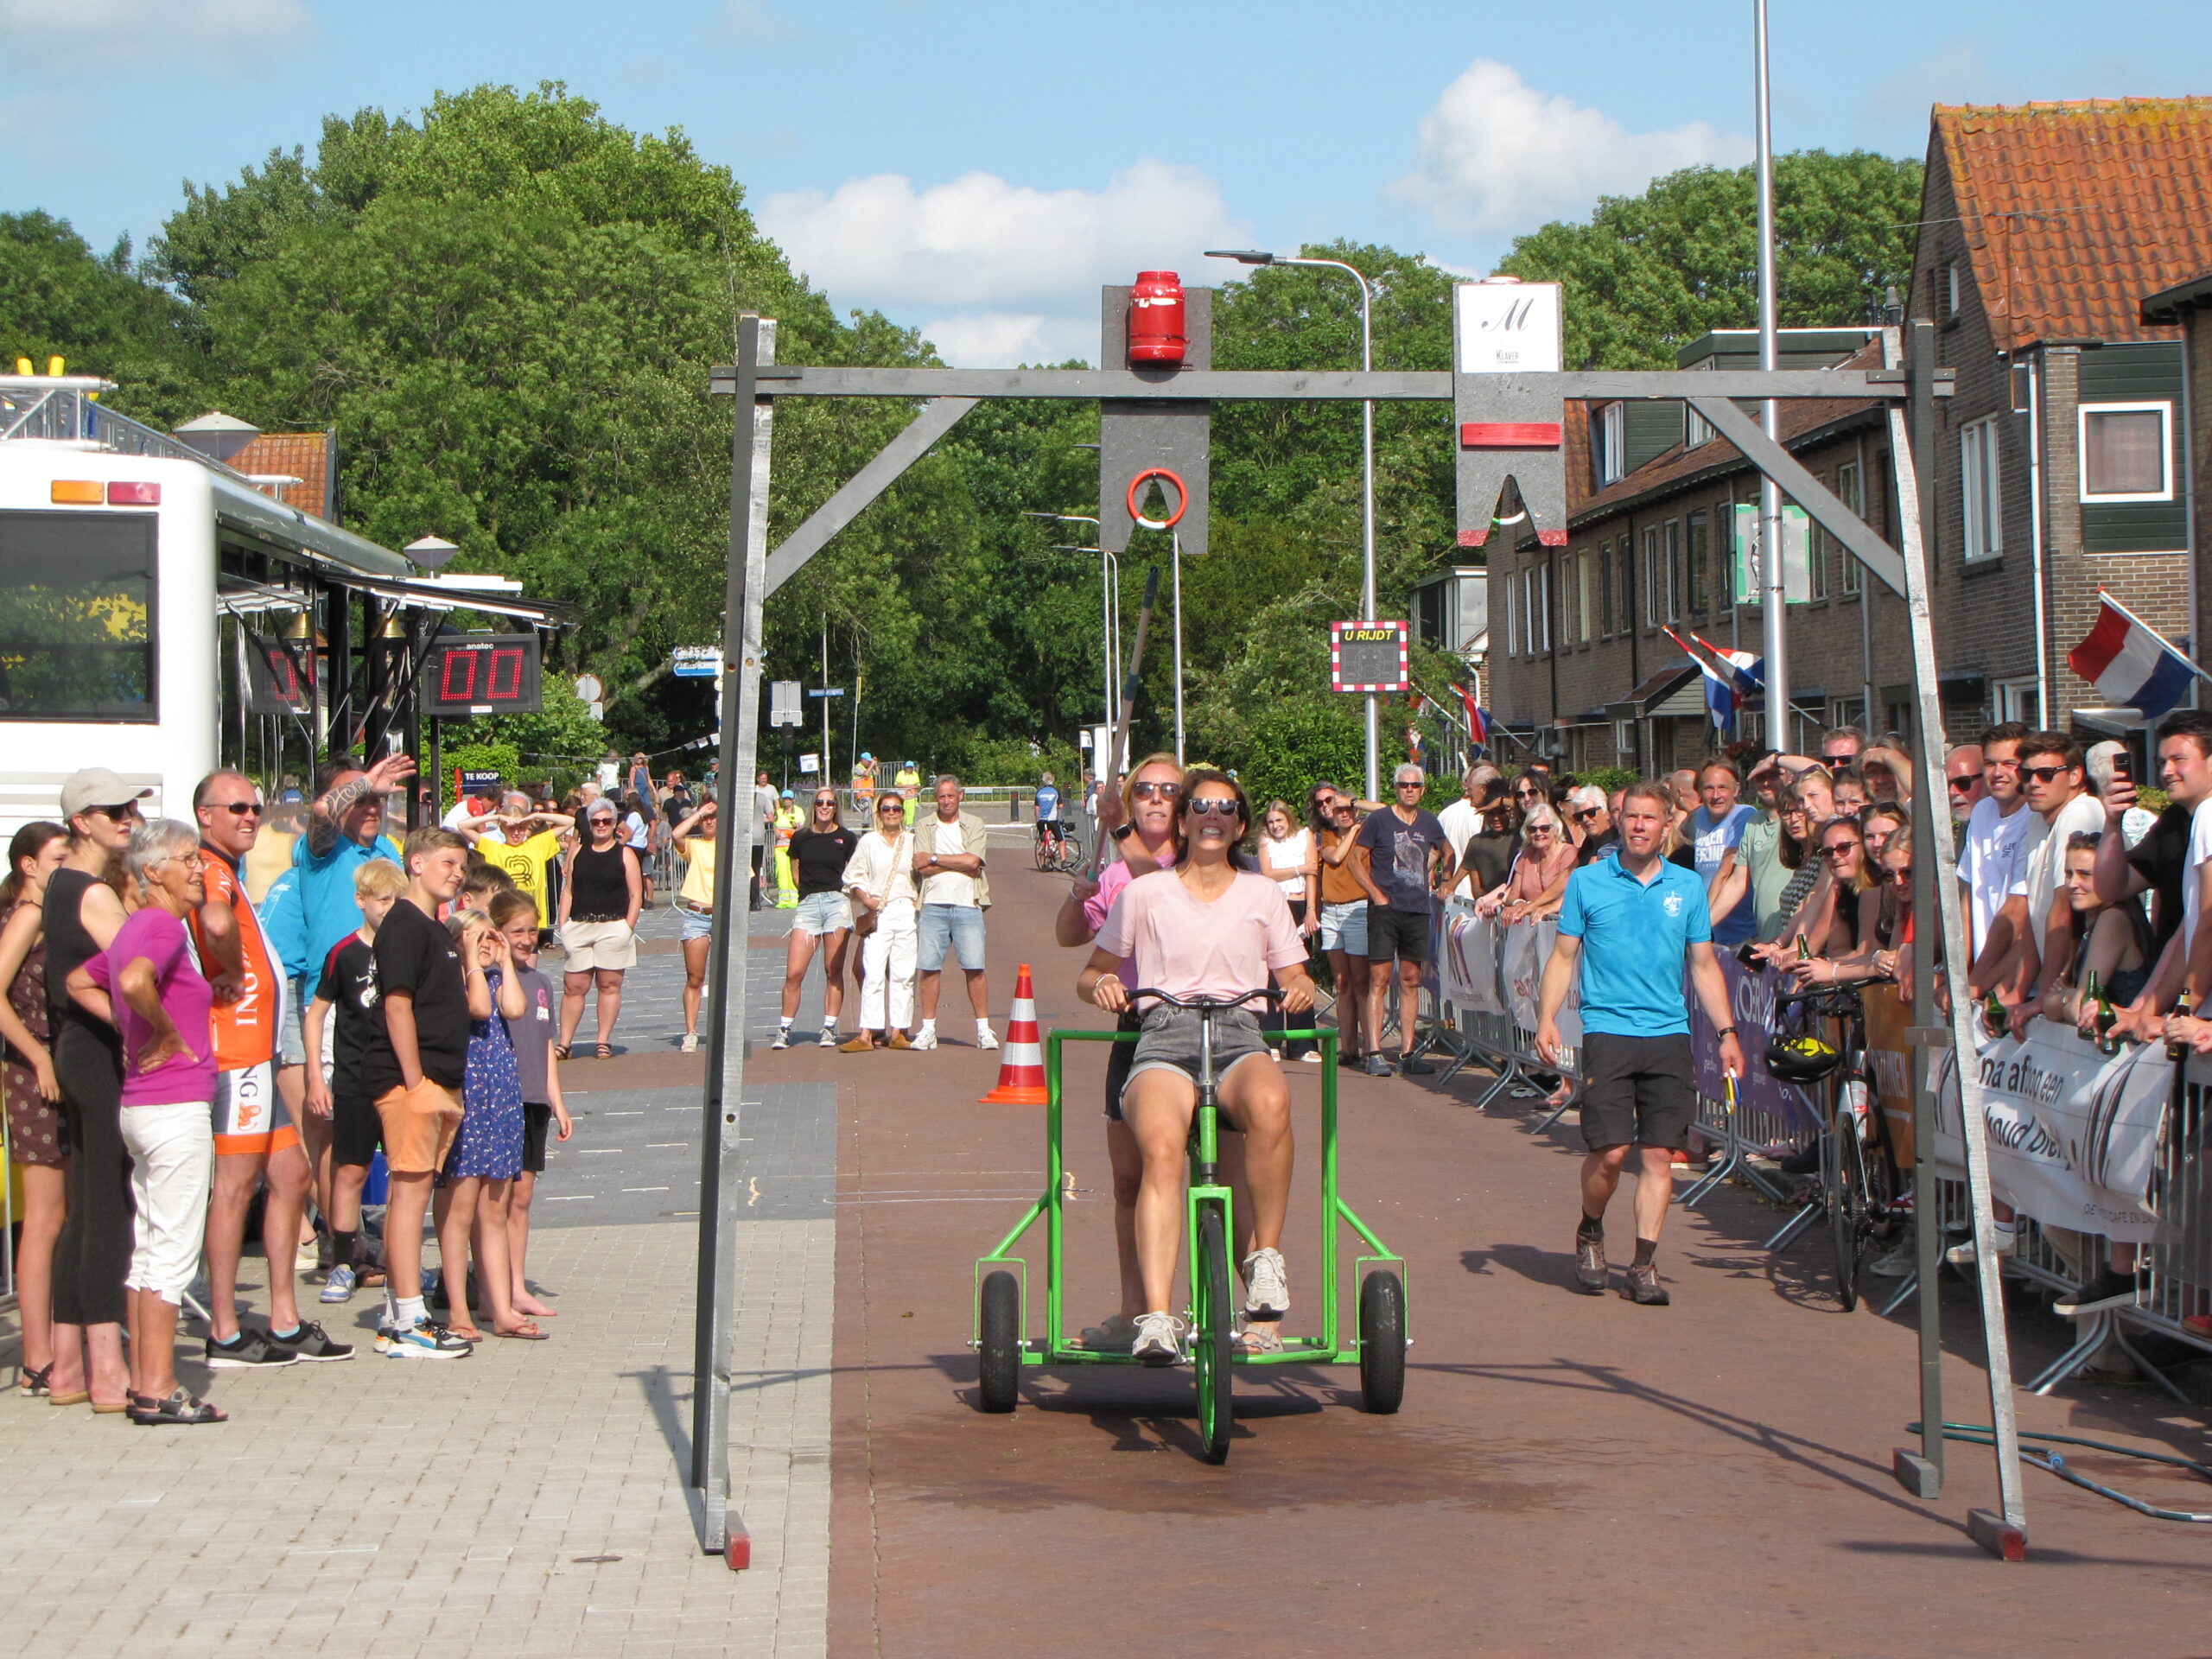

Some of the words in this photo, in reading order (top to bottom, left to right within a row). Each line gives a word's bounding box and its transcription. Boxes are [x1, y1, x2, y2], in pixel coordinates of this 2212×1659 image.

[1344, 630, 1355, 641] U
[1357, 630, 1394, 641] RIJDT
[466, 642, 494, 651] anatec
[465, 772, 475, 781] TE
[476, 772, 499, 780] KOOP
[1979, 1057, 2005, 1088] na
[239, 1065, 258, 1099] NG
